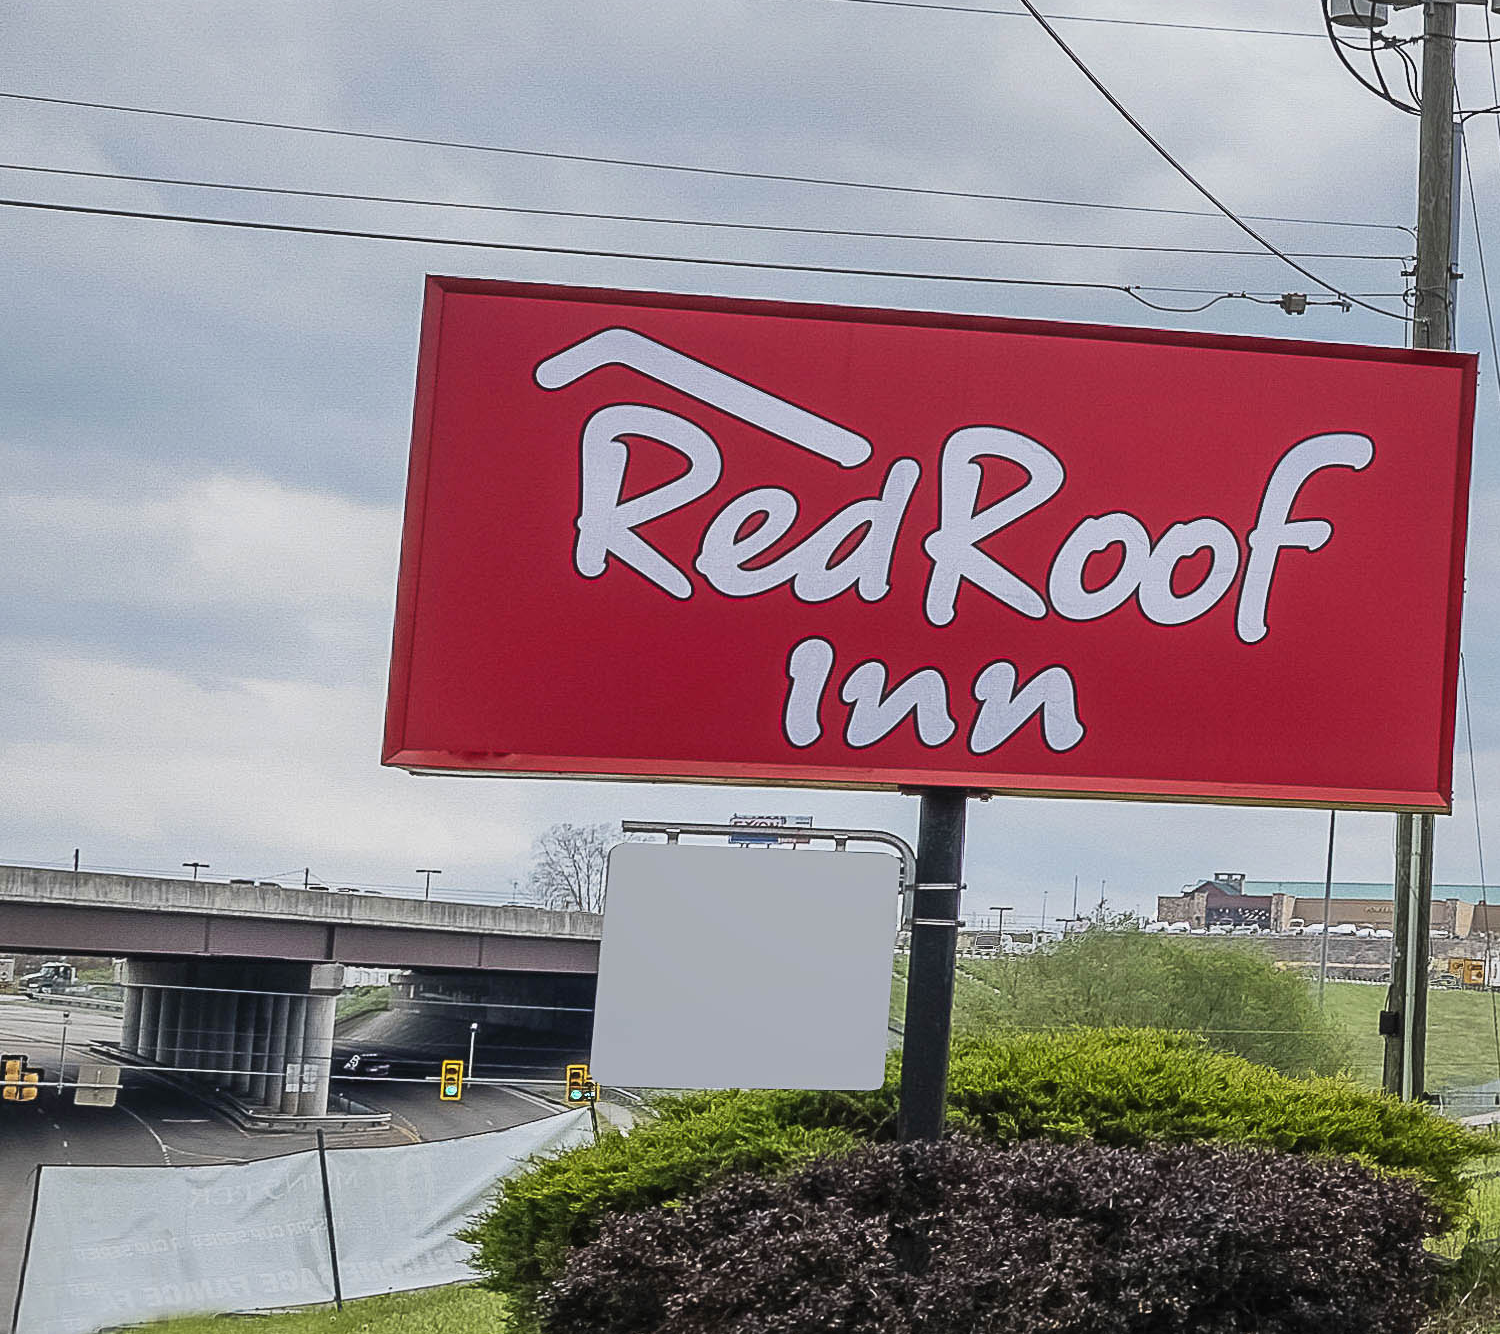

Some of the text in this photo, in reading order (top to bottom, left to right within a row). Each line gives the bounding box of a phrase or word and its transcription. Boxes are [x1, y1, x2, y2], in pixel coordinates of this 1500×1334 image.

[574, 402, 1375, 644] Red Roof
[783, 636, 1086, 756] Inn
